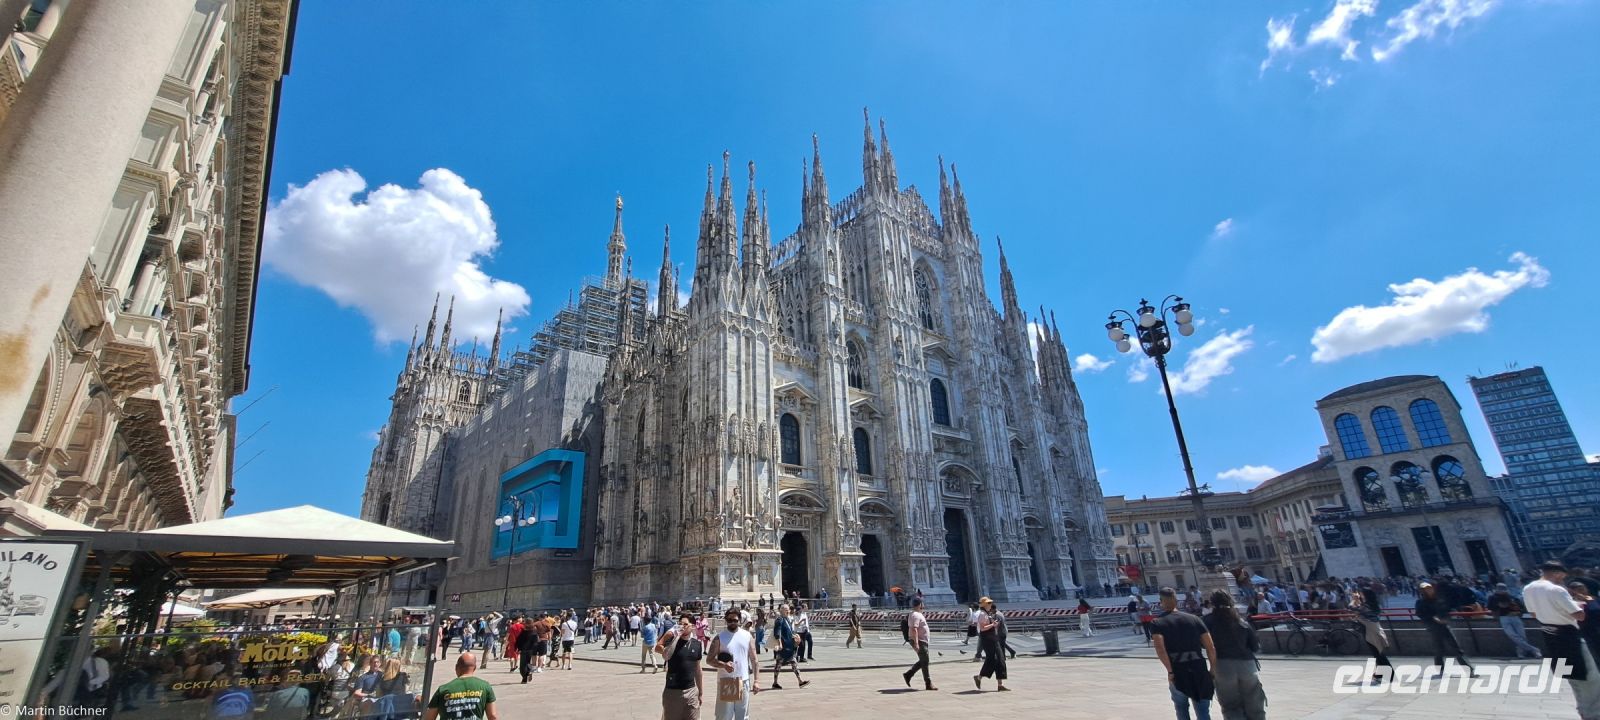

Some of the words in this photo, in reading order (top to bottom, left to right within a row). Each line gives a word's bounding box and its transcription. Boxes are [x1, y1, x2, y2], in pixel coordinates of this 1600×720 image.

[240, 641, 309, 663] Motta
[172, 680, 233, 690] OCKTAIL
[269, 674, 281, 683] &
